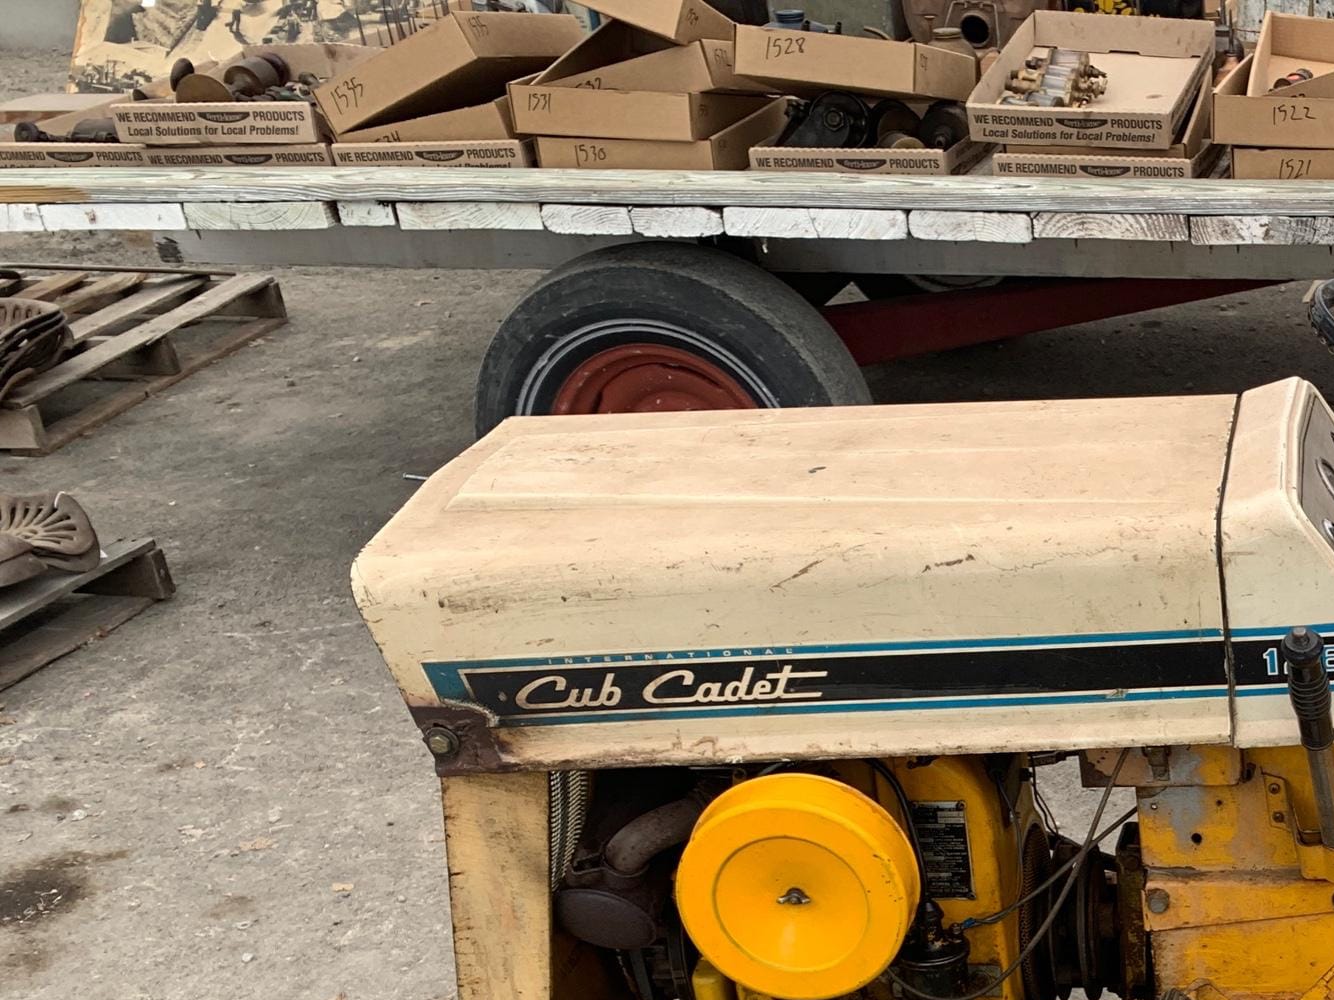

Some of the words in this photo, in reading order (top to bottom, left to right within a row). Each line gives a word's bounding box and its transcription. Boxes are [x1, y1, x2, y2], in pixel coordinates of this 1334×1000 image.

[765, 36, 807, 60] 1528
[527, 93, 551, 115] 1531
[116, 112, 132, 122] WE
[133, 111, 196, 122] RECOMMEND
[252, 111, 305, 121] PRODUCTS
[973, 114, 990, 124] WE
[992, 115, 1054, 127] RECOMMEND
[1110, 119, 1162, 129] PRODUCTS
[1272, 104, 1317, 125] 1522
[127, 126, 152, 137] Local
[155, 126, 201, 137] Solutions
[204, 125, 217, 135] for
[221, 125, 246, 135] Local
[250, 124, 299, 135] Problems!
[982, 128, 1009, 138] Local
[1011, 129, 1057, 140] Solutions
[1059, 130, 1074, 140] for
[1076, 131, 1102, 141] Local
[1105, 132, 1155, 143] Problems!
[96, 151, 144, 161] PRODUCTS
[146, 155, 162, 165] WE
[164, 154, 223, 165] RECOMMEND
[275, 153, 325, 163] PRODUCTS
[337, 152, 354, 162] WE
[356, 150, 414, 161] RECOMMEND
[466, 148, 516, 159] PRODUCTS
[574, 144, 607, 167] 1530
[756, 158, 772, 168] WE
[773, 158, 834, 168] RECOMMEND
[889, 158, 940, 169] PRODUCTS
[998, 163, 1014, 173] WE
[1015, 163, 1077, 174] RECOMMEND
[1133, 166, 1184, 177] PRODUCTS
[1279, 158, 1312, 179] 1521
[548, 647, 793, 665] INTERNATIONAL
[515, 672, 622, 710] Cub
[641, 664, 829, 705] Cadet
